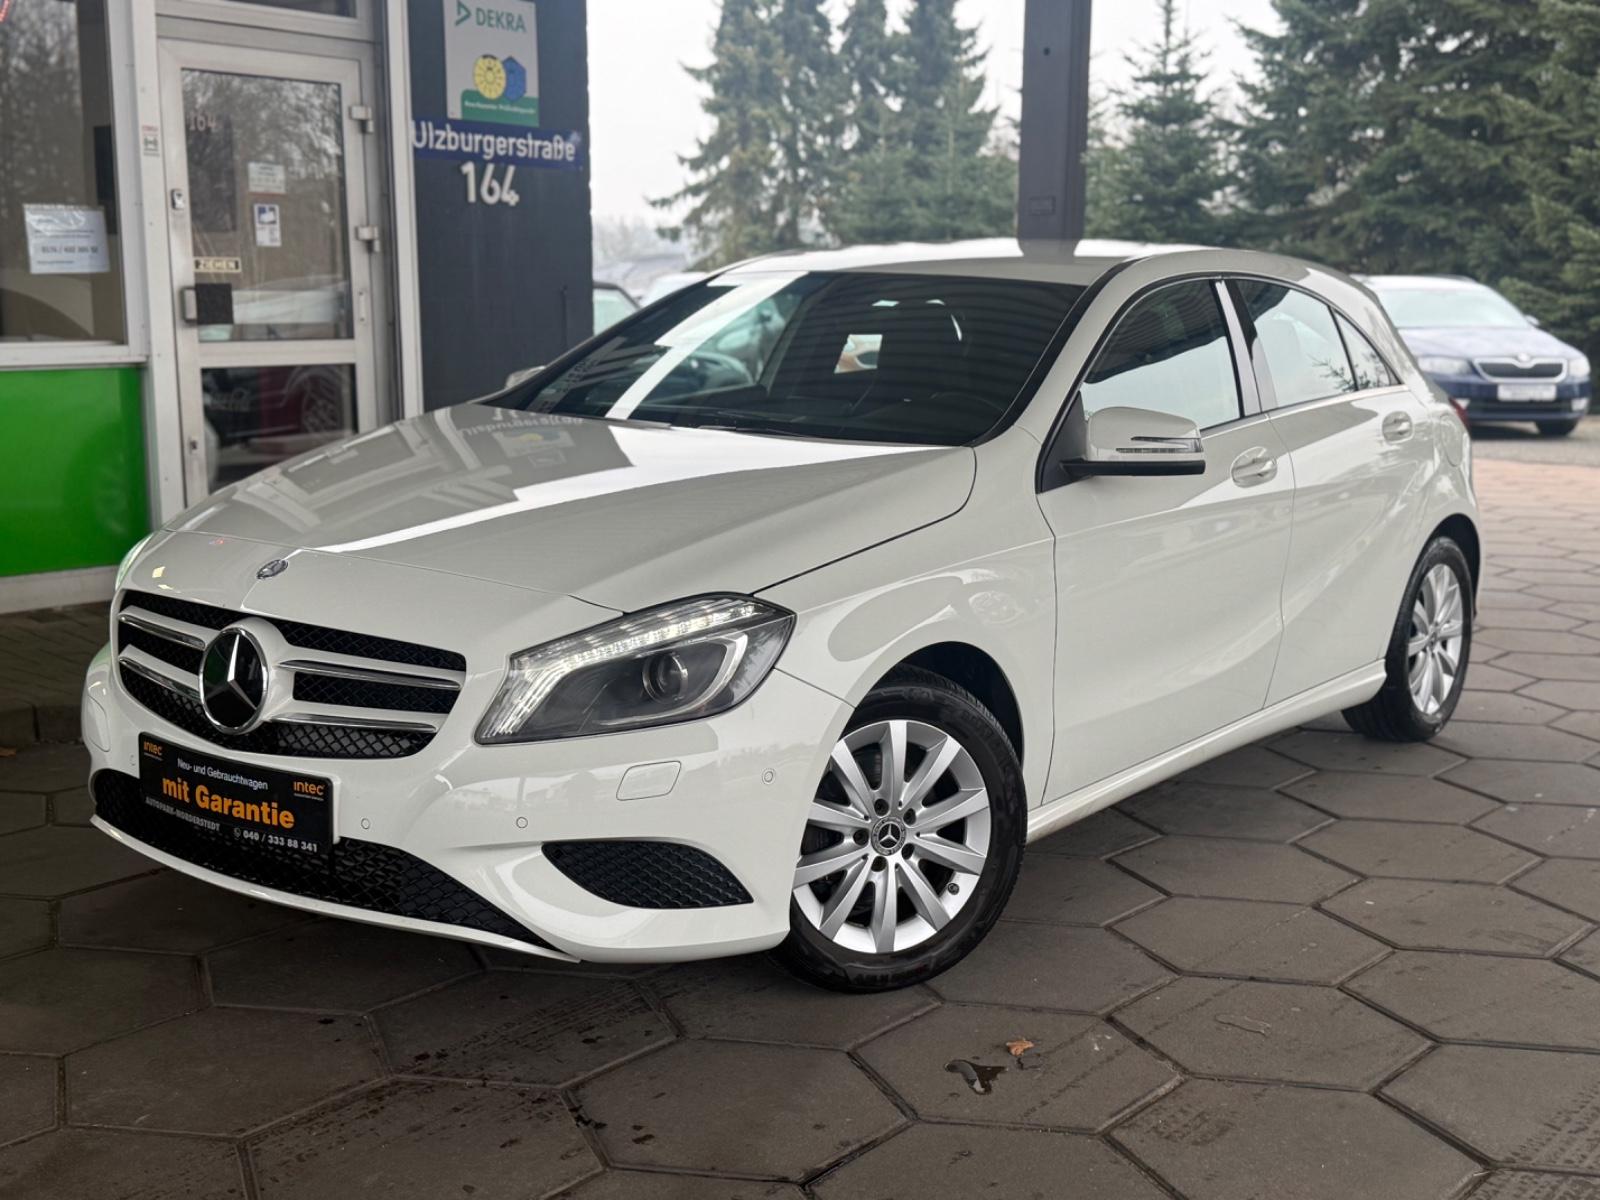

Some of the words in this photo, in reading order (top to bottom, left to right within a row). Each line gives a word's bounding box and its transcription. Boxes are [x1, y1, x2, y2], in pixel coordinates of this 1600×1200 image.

[475, 8, 527, 33] DEKRA
[411, 120, 576, 161] Ulzburgerstraße
[460, 161, 519, 206] 164
[177, 757, 192, 770] Neu-
[193, 764, 206, 776] und
[206, 766, 269, 790] Gebrauchtwagen
[293, 781, 325, 796] intec
[162, 777, 190, 804] mit
[195, 784, 295, 829] Garantie
[242, 829, 260, 841] 040
[267, 834, 285, 846] 333
[287, 838, 299, 849] 88
[300, 841, 318, 853] 341
